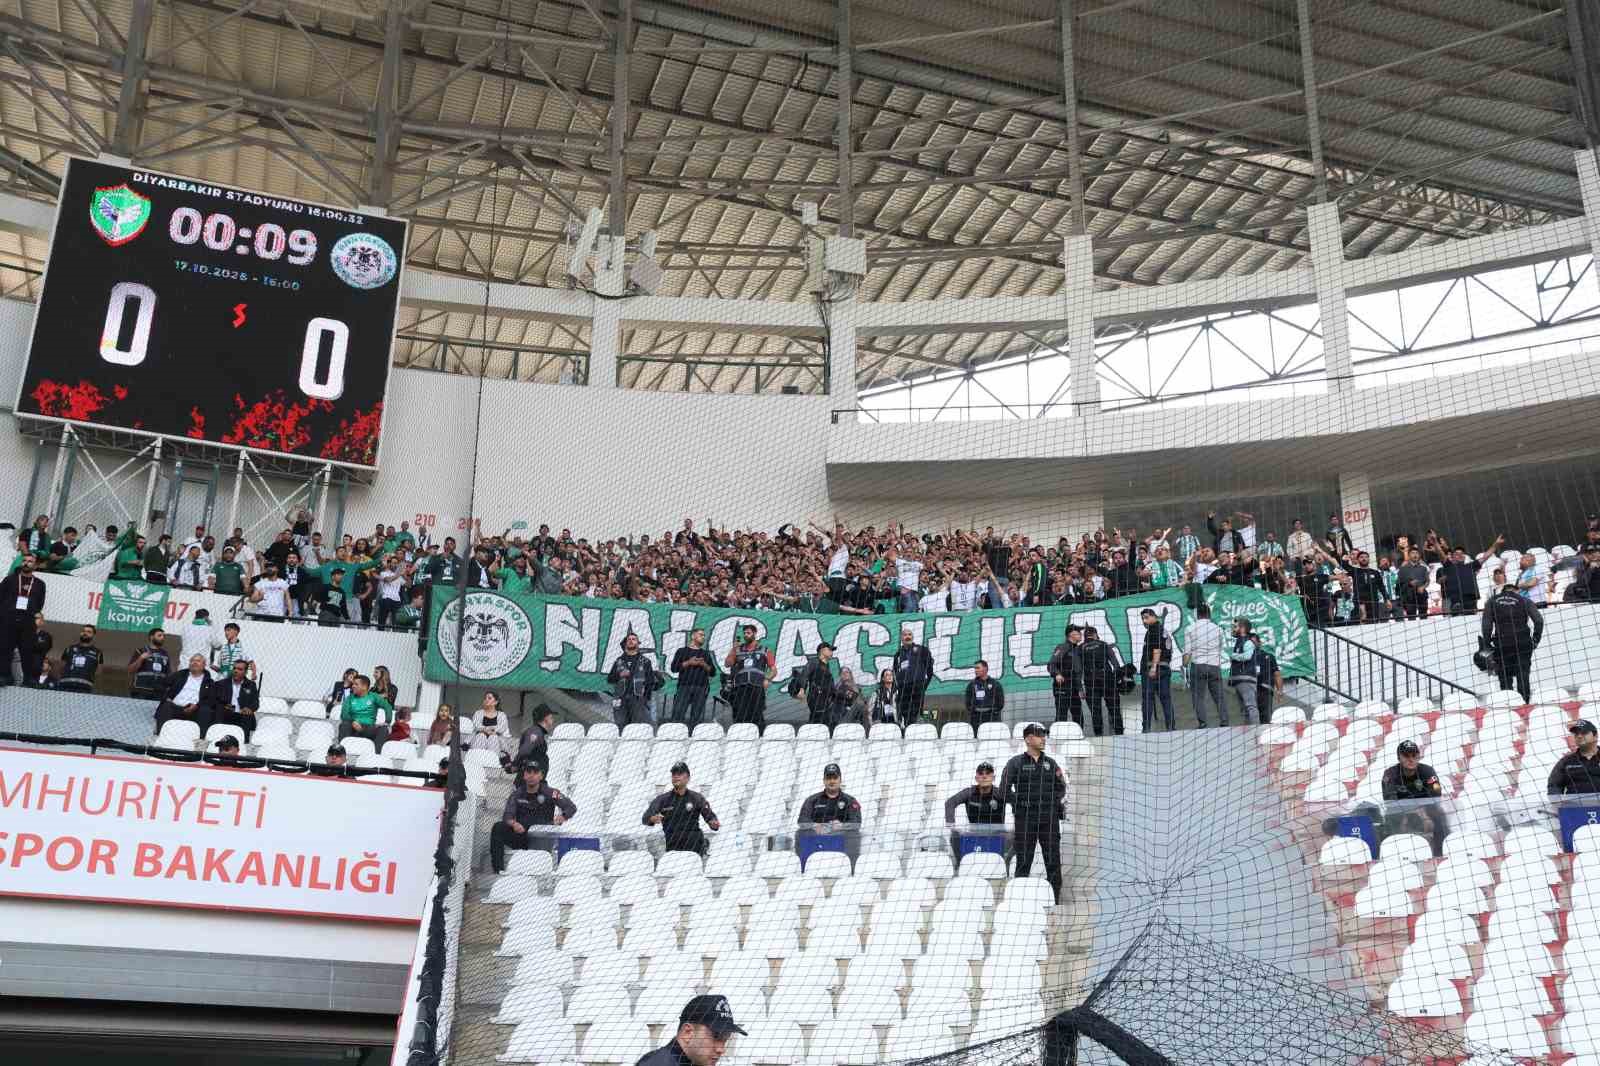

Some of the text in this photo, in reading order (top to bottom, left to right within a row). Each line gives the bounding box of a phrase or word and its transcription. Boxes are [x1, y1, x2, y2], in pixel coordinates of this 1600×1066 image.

[133, 172, 222, 198] DİYARBAKIR
[226, 190, 304, 213] STADYUMU
[169, 207, 318, 265] 00:09
[99, 281, 157, 366] 0
[299, 317, 350, 400] 0
[415, 513, 436, 527] 210
[1344, 508, 1369, 523] 207
[163, 601, 190, 620] 07
[1220, 600, 1268, 618] Since
[133, 842, 398, 895] BAKANLIĞI
